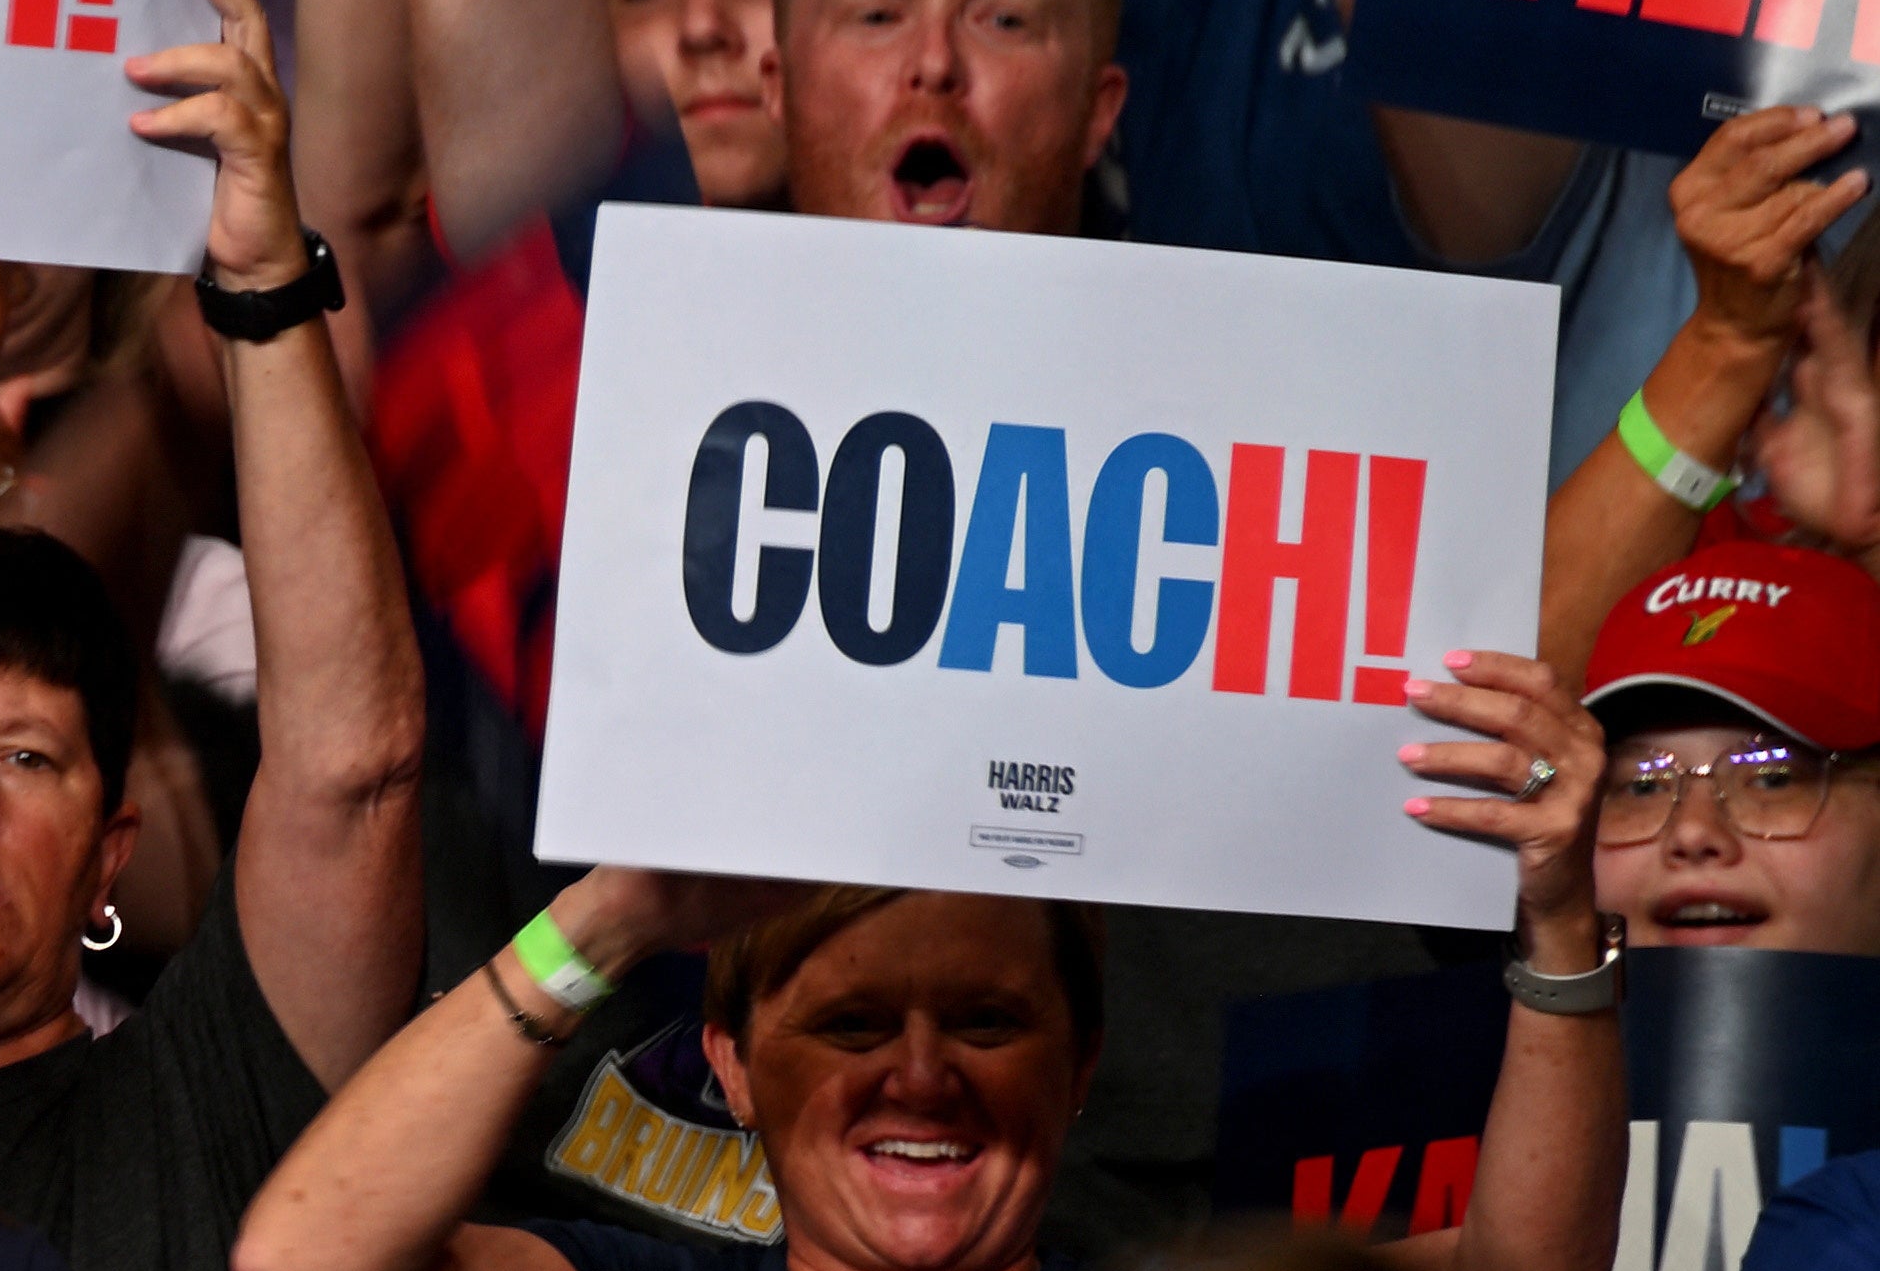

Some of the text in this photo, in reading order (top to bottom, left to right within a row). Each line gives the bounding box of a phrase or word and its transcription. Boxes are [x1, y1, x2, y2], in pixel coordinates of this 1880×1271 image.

[683, 400, 1427, 707] COACH!
[988, 760, 1076, 796] HARRIS
[999, 792, 1061, 814] WALZ
